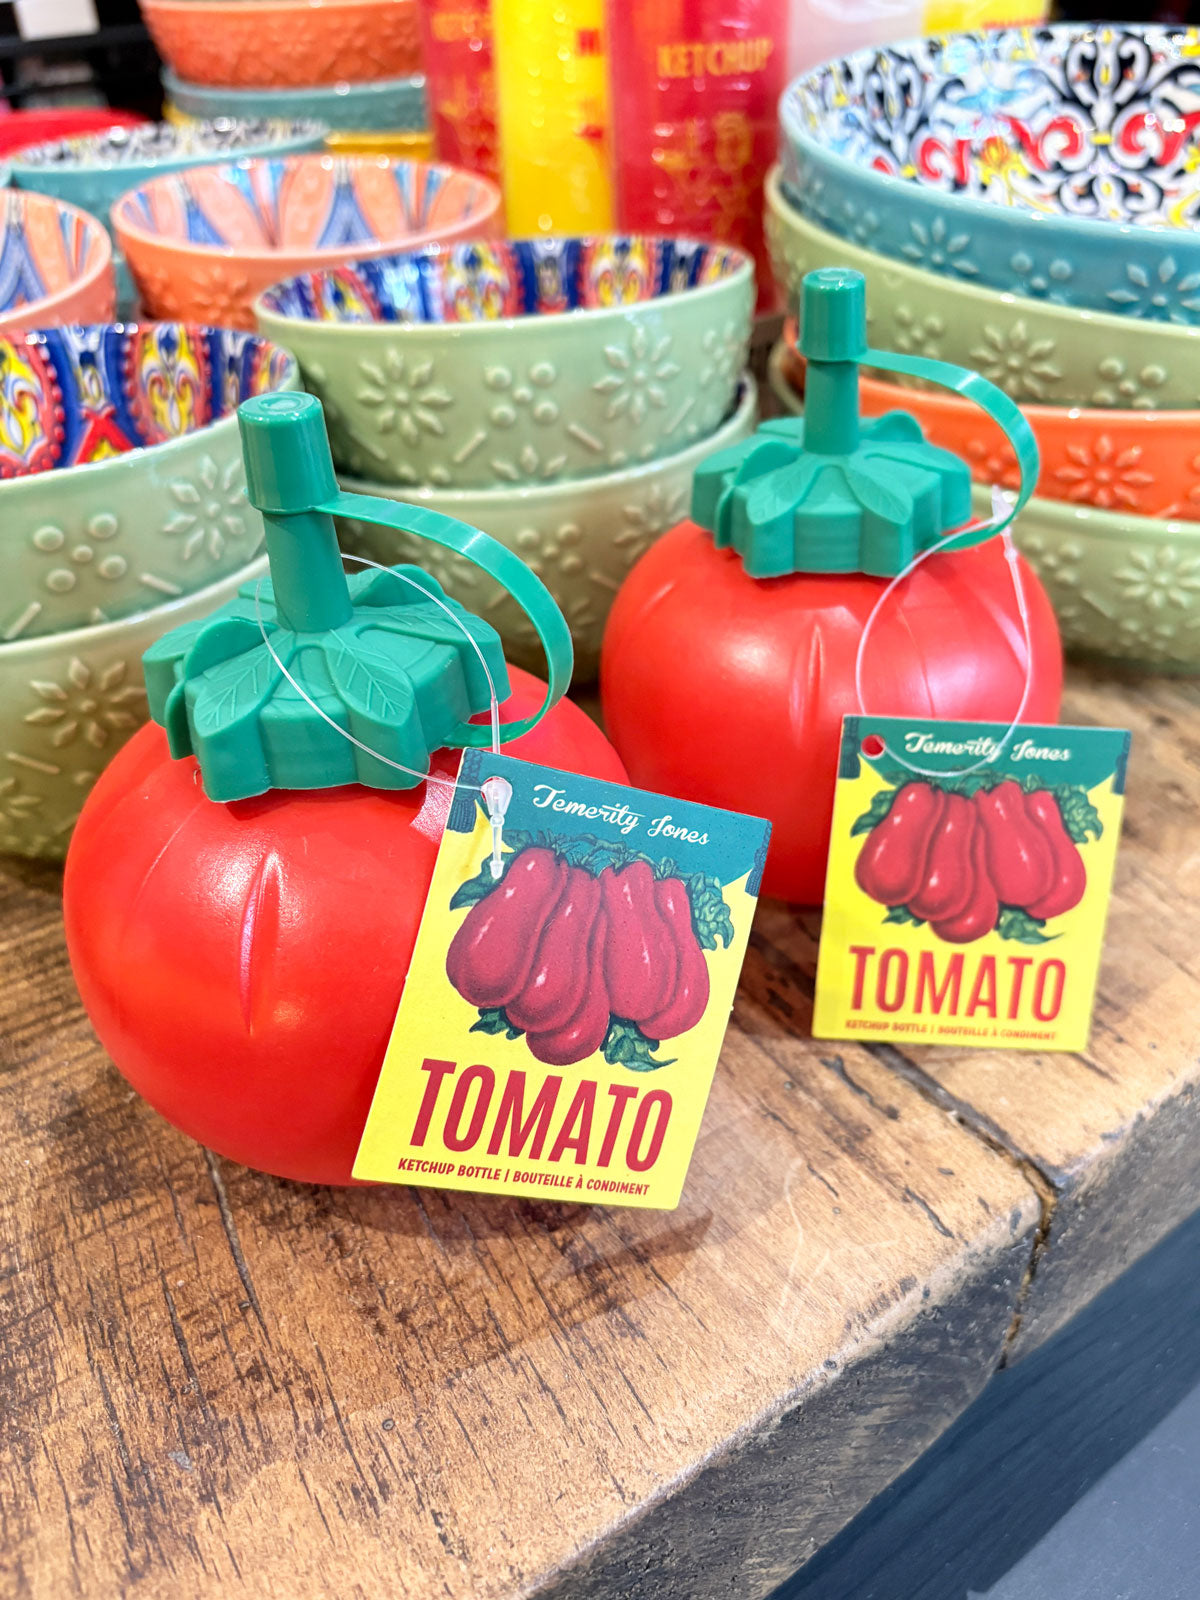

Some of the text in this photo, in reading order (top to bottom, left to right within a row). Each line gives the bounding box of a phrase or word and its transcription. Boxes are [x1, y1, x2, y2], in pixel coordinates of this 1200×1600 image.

[903, 732, 1072, 763] Temerity Jones
[532, 784, 710, 845] Temerity Jones
[849, 945, 1066, 1022] TOMATO
[845, 1019, 890, 1031] KETCHUP
[892, 1022, 928, 1034] BOTTLE
[409, 1058, 673, 1173] TOMATO
[397, 1157, 455, 1176] KETCHUP
[456, 1164, 502, 1181] BOTTLE
[512, 1170, 574, 1189] BOUTEILLE
[575, 1174, 584, 1190] À
[586, 1178, 650, 1196] CONDIMENT
